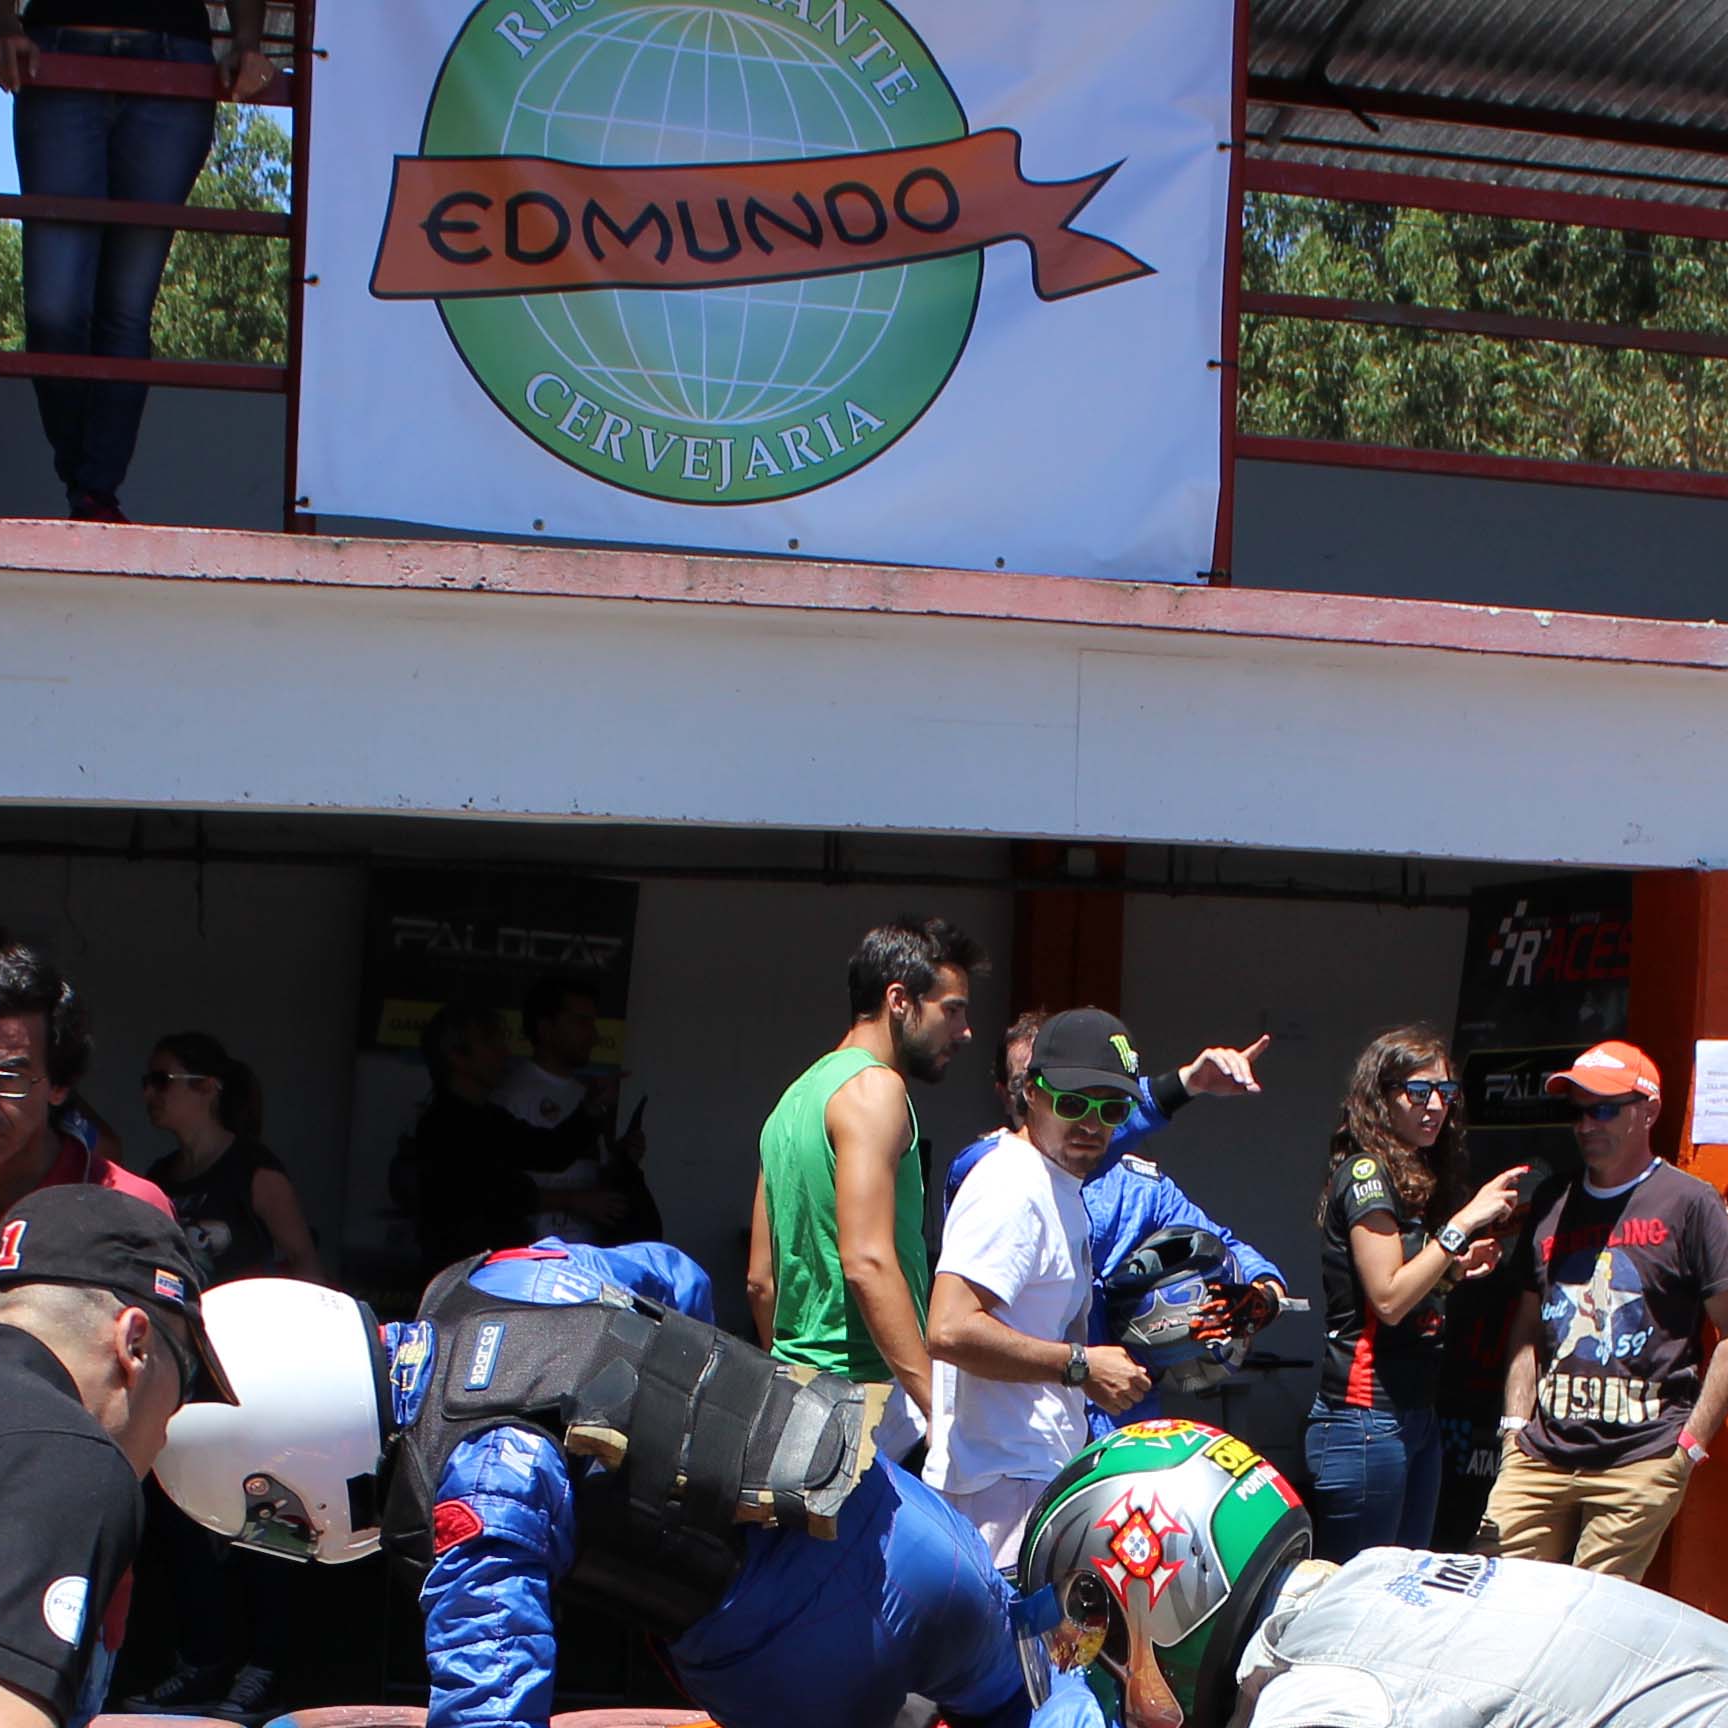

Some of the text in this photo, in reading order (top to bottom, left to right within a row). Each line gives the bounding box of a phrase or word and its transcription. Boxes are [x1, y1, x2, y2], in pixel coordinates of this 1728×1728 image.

[420, 166, 961, 266] EDMUNDO
[524, 370, 887, 493] CERVEJARIA
[471, 1325, 497, 1385] sparco
